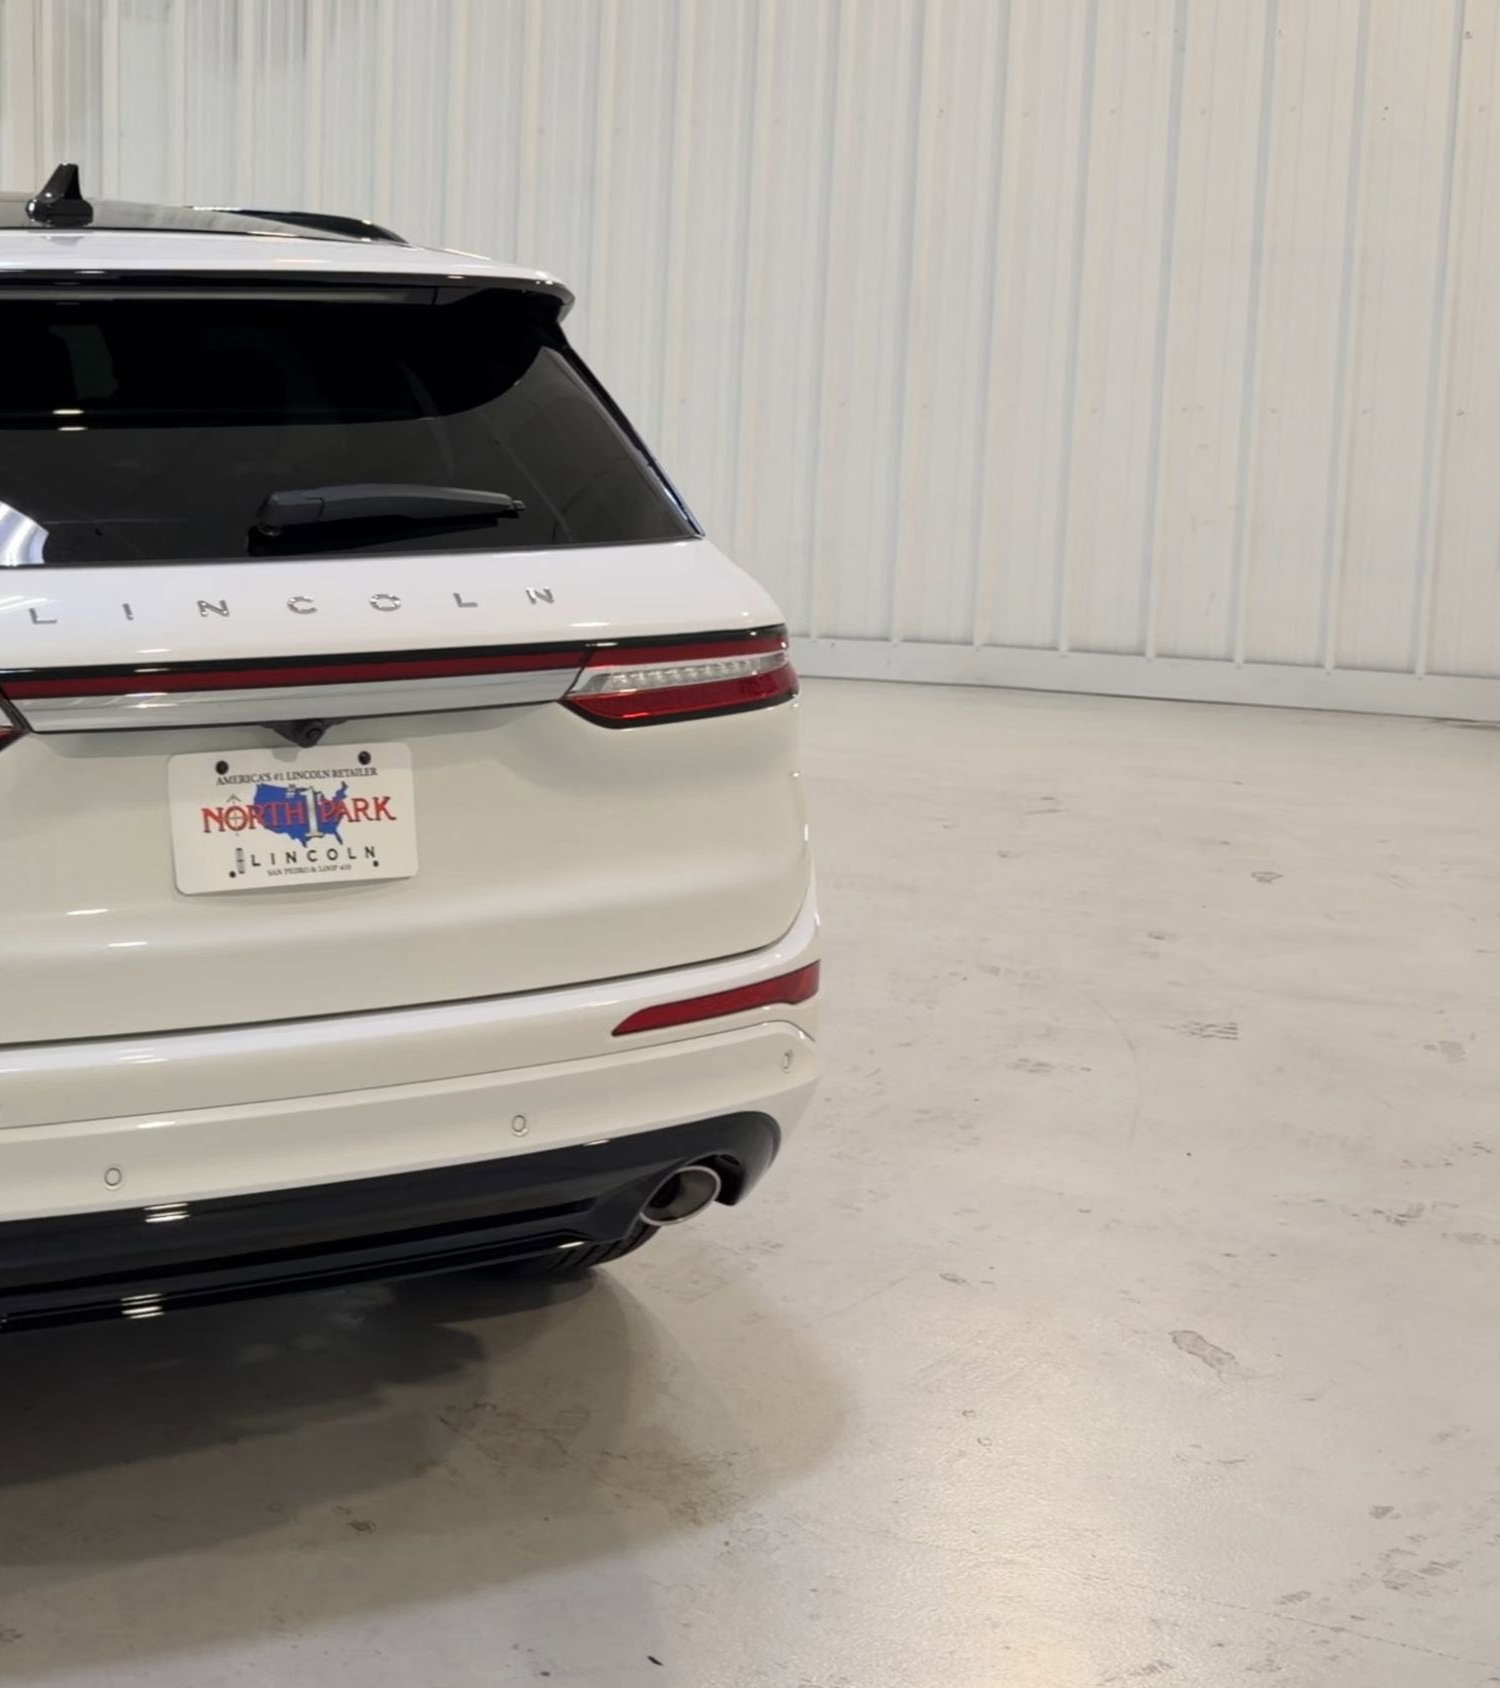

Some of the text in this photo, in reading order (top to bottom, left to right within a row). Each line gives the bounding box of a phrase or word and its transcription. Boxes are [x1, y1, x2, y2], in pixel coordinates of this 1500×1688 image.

[29, 585, 555, 626] LINCOLN
[216, 772, 271, 786] AMERICA'S
[286, 769, 331, 781] LINCOLN
[332, 767, 378, 778] RETAILER
[201, 796, 397, 833] NORTH PARK
[251, 846, 376, 867] LINCOLN
